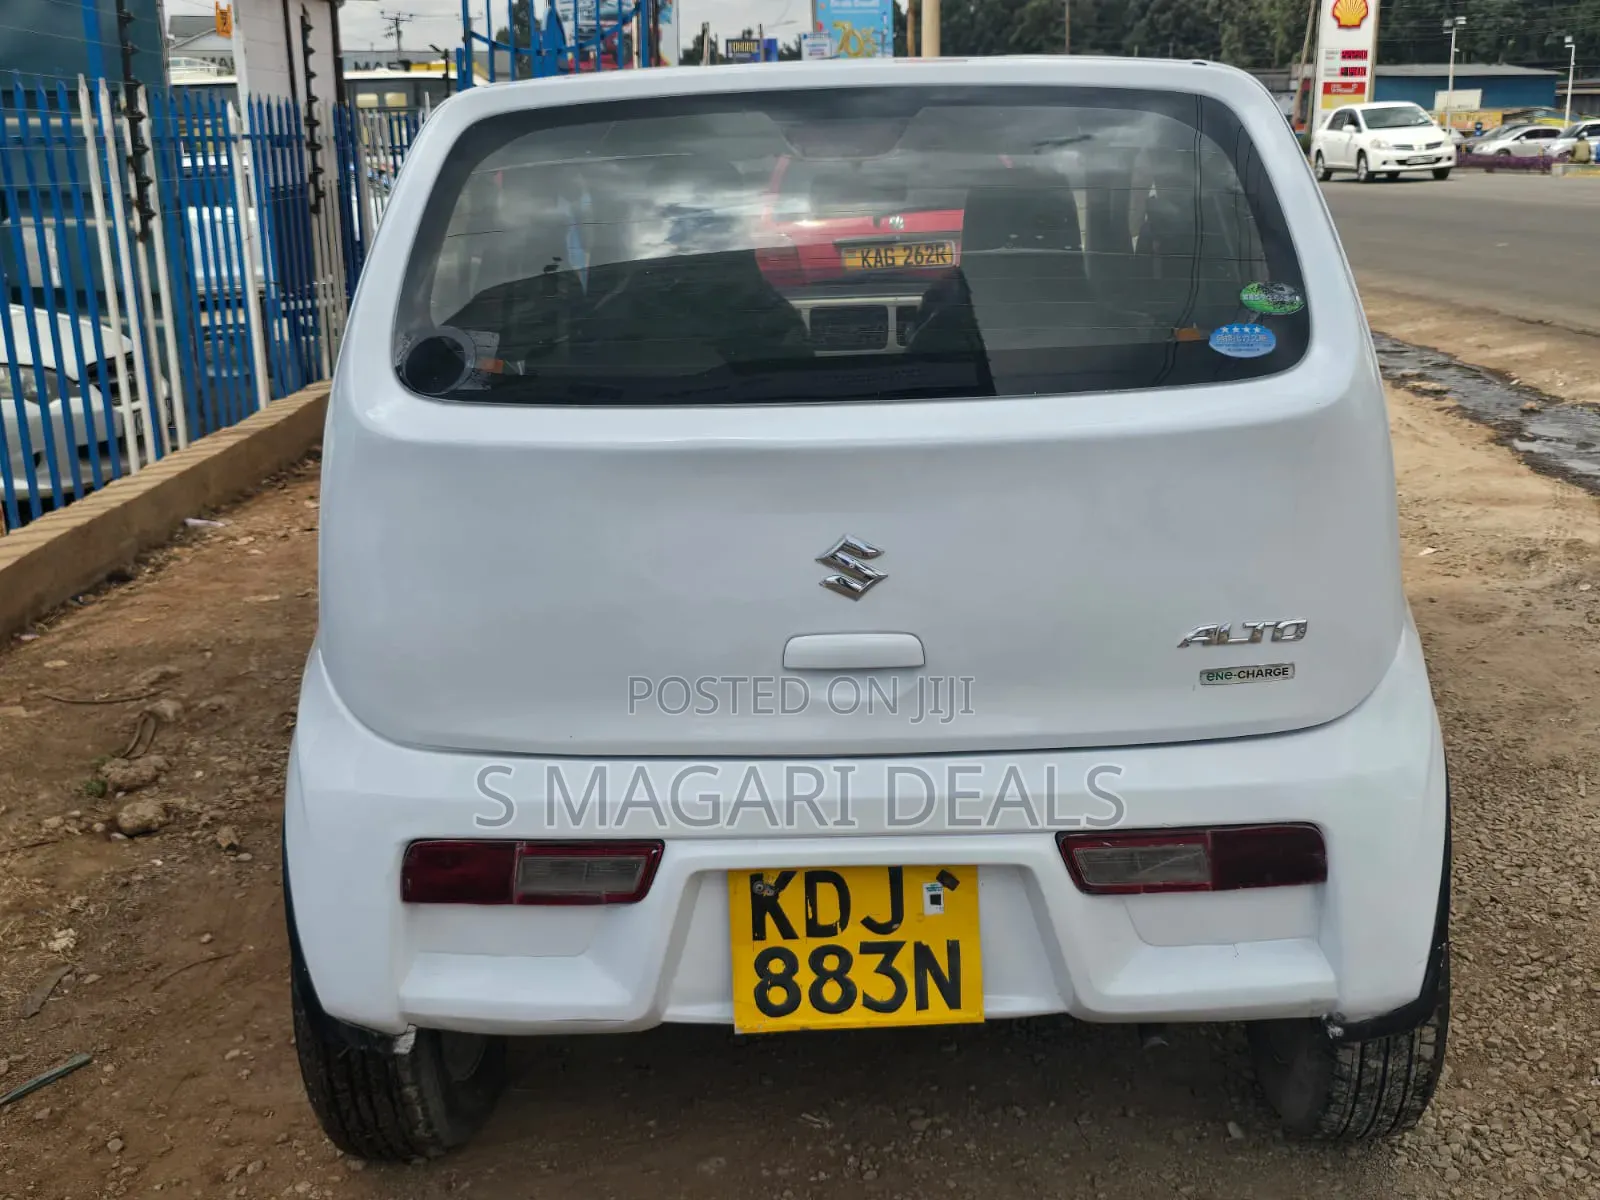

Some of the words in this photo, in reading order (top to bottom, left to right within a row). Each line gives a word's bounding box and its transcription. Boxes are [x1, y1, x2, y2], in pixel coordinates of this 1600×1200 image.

[1177, 618, 1308, 648] ALTO
[750, 866, 905, 941] KDJ
[753, 940, 962, 1018] 883N
